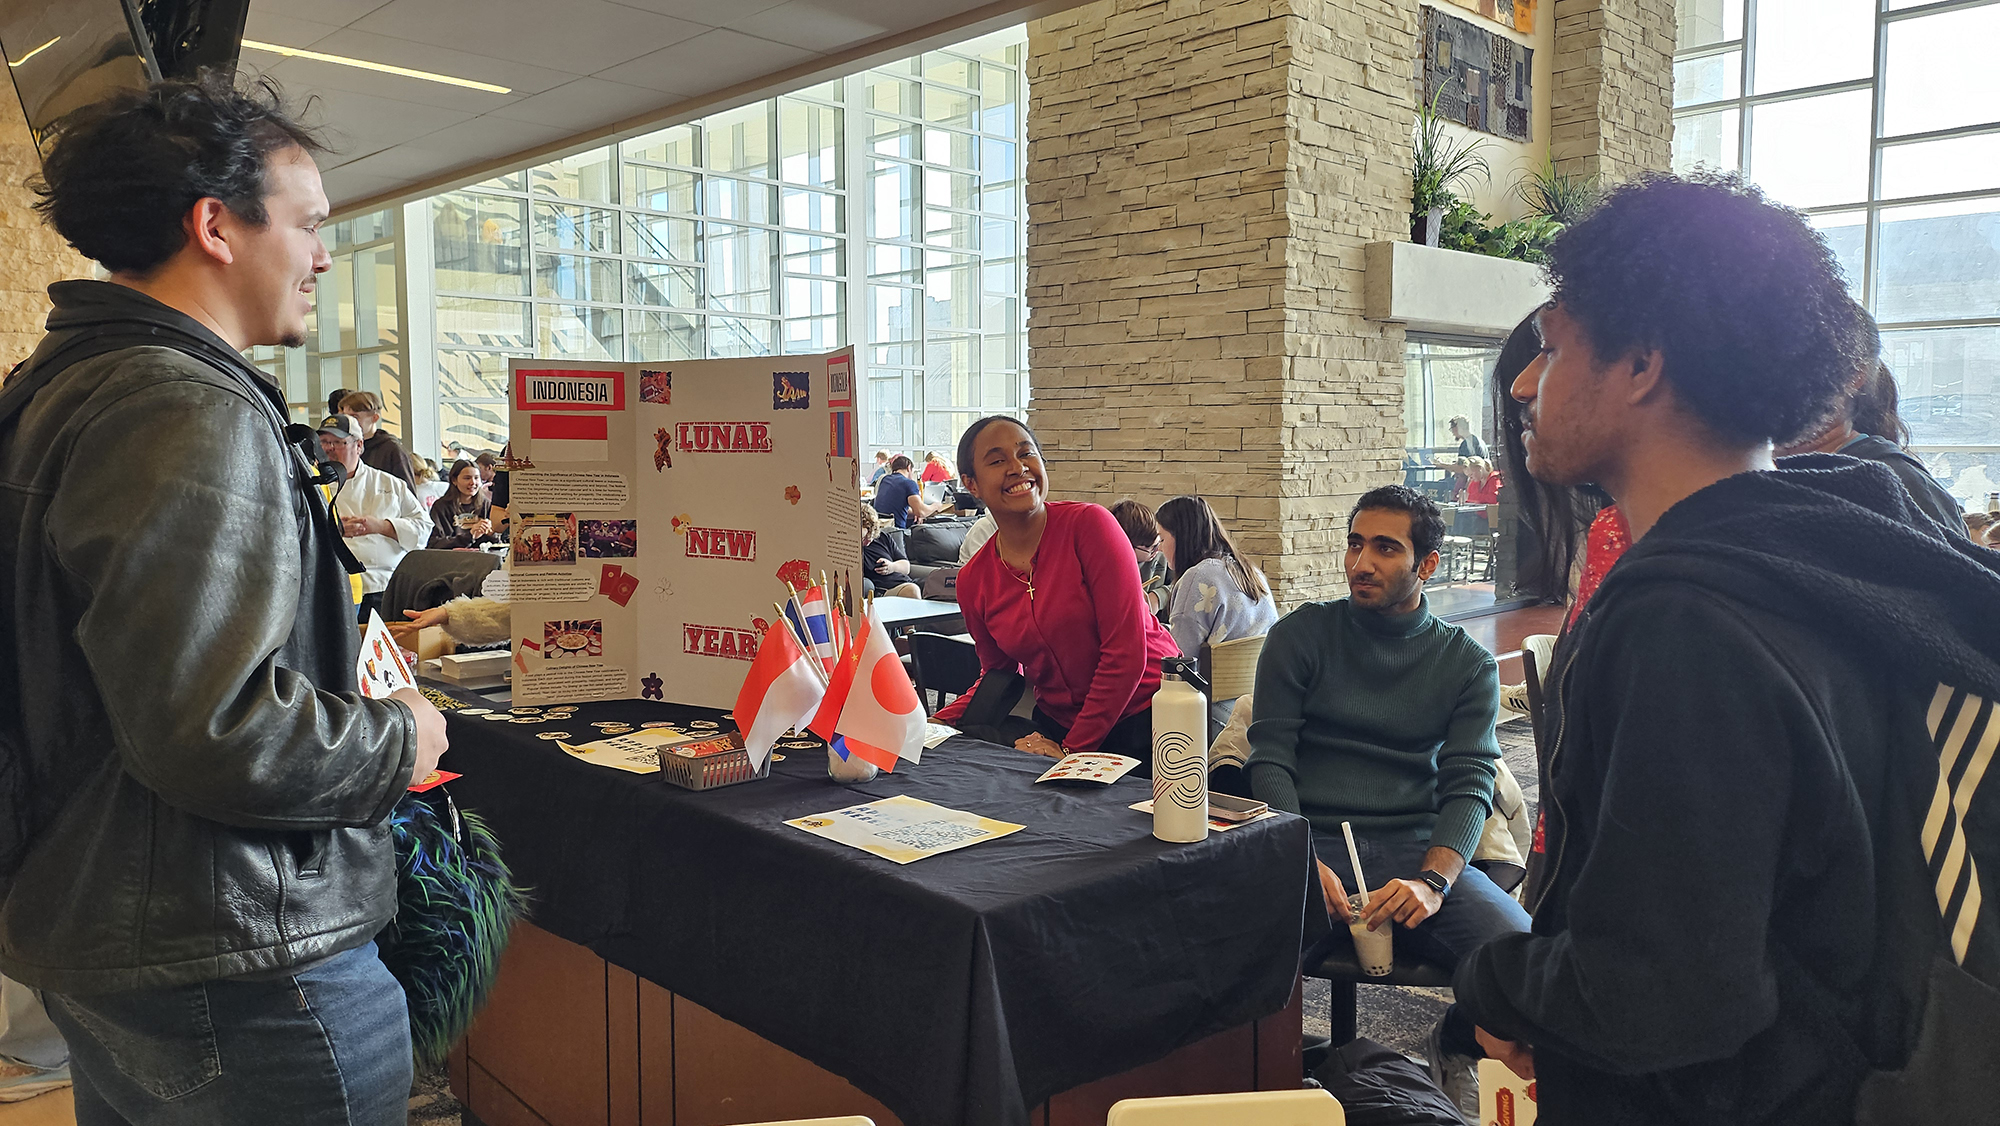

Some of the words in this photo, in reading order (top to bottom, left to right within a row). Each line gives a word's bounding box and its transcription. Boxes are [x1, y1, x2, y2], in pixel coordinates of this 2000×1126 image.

[532, 380, 608, 402] INDONESIA
[678, 425, 769, 450] LUNAR
[688, 530, 753, 558] NEW
[685, 628, 757, 658] YEAR
